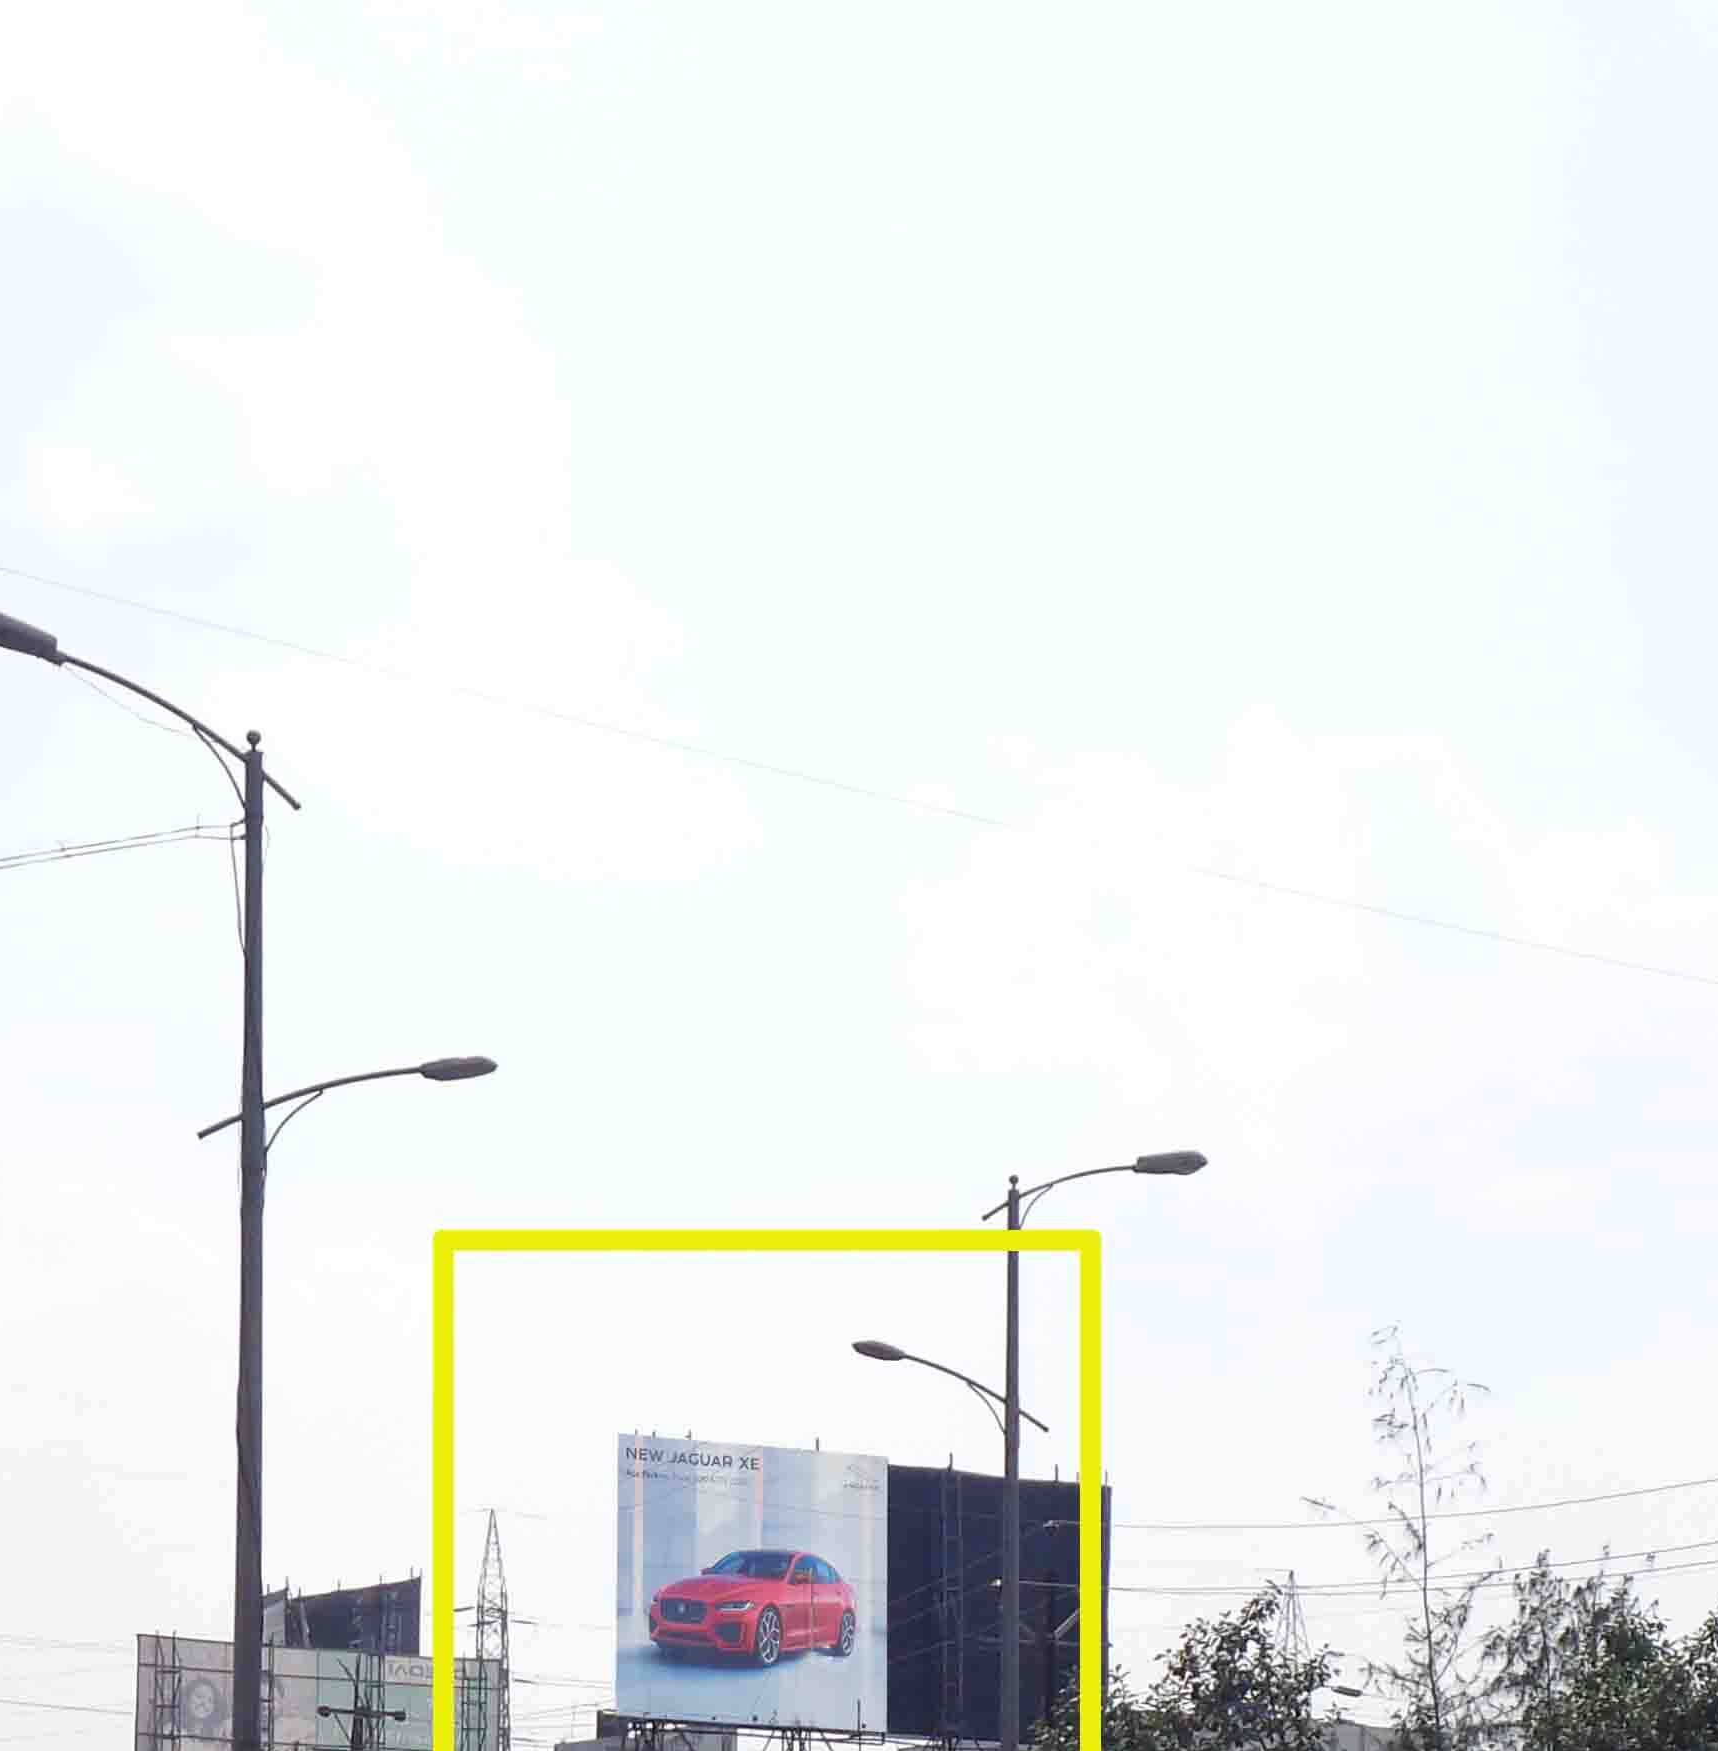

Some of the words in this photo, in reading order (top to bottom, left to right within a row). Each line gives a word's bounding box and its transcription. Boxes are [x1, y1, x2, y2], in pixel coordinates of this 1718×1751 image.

[626, 1447, 663, 1462] NEW
[667, 1451, 733, 1467] JAGUAR
[739, 1456, 760, 1470] XE
